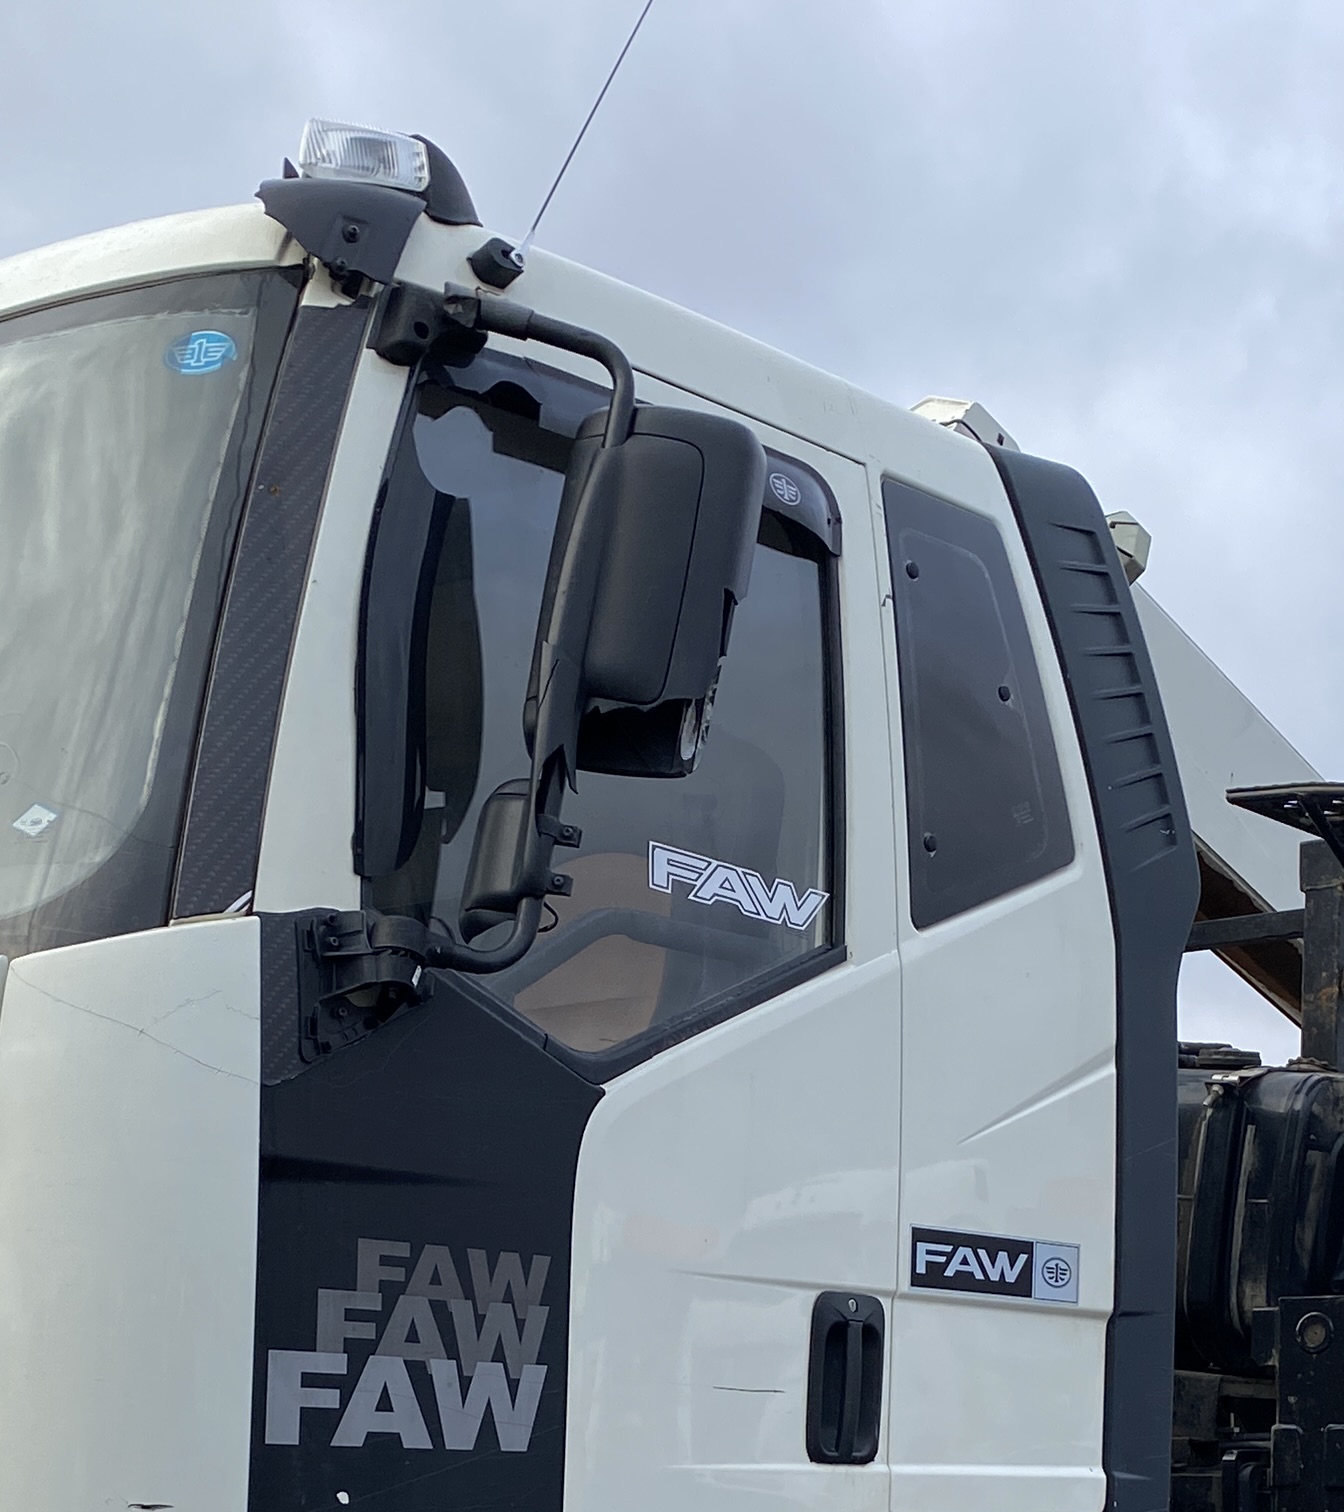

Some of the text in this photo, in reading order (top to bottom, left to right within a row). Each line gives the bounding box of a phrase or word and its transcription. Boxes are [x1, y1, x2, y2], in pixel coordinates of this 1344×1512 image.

[648, 841, 830, 930] FAW
[357, 1238, 551, 1319] FAW
[916, 1242, 1029, 1283] FAW
[317, 1288, 550, 1379] FAW
[264, 1350, 548, 1452] FAW
